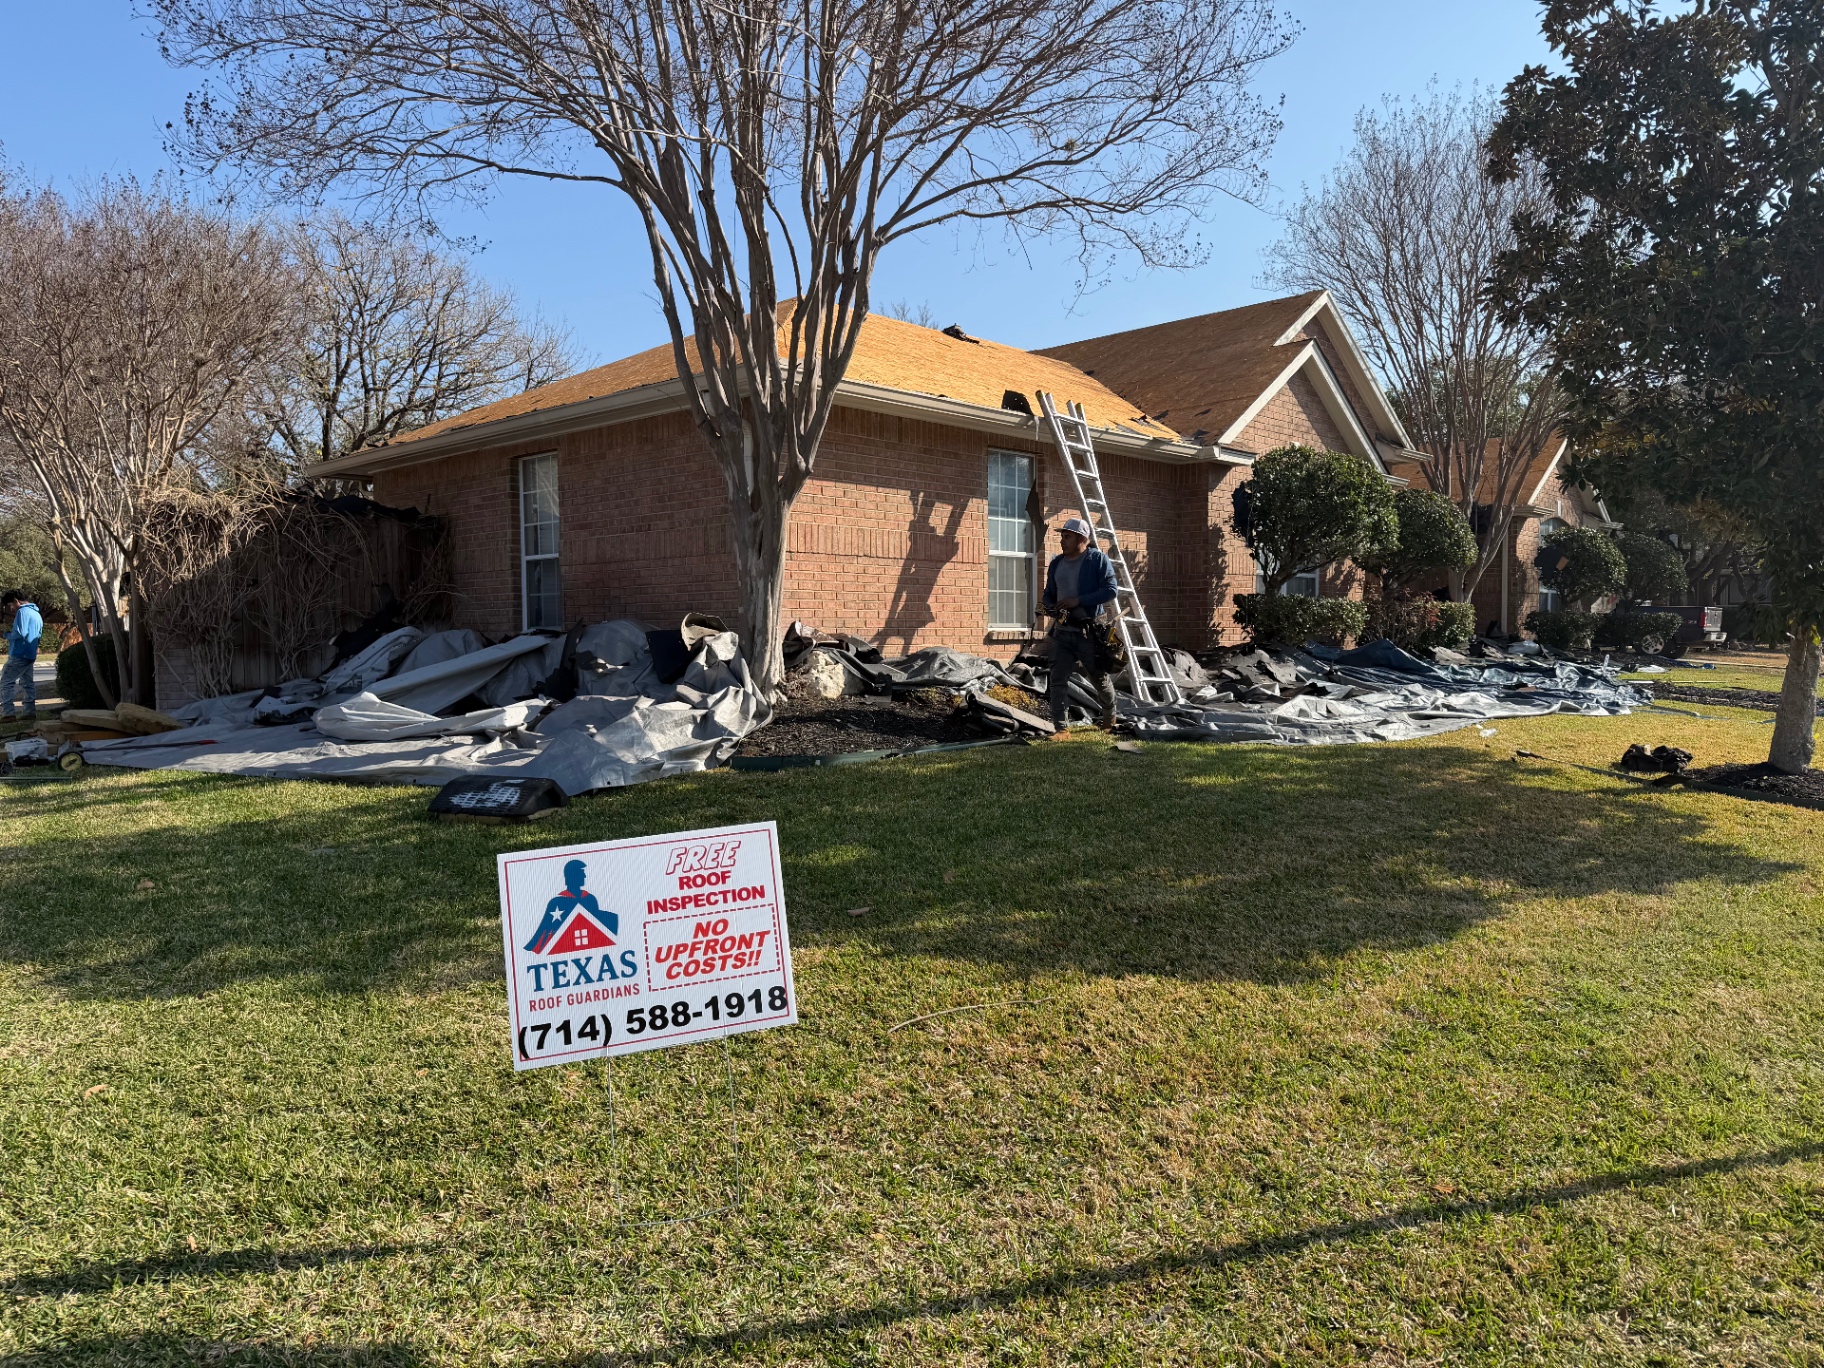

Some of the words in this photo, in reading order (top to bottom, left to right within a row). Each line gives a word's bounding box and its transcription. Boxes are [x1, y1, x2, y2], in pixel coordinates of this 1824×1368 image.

[666, 840, 741, 875] FREE
[678, 870, 732, 890] ROOF
[647, 885, 765, 914] INSPECTION
[693, 919, 728, 938] NO
[655, 930, 771, 963] UPFRONT
[527, 950, 638, 992] TEXAS
[666, 950, 762, 980] COSTS!!
[529, 995, 561, 1012] ROOF
[567, 984, 640, 1005] GUARDIANS
[518, 1014, 612, 1058] (714)
[626, 986, 787, 1034] 588-1918
